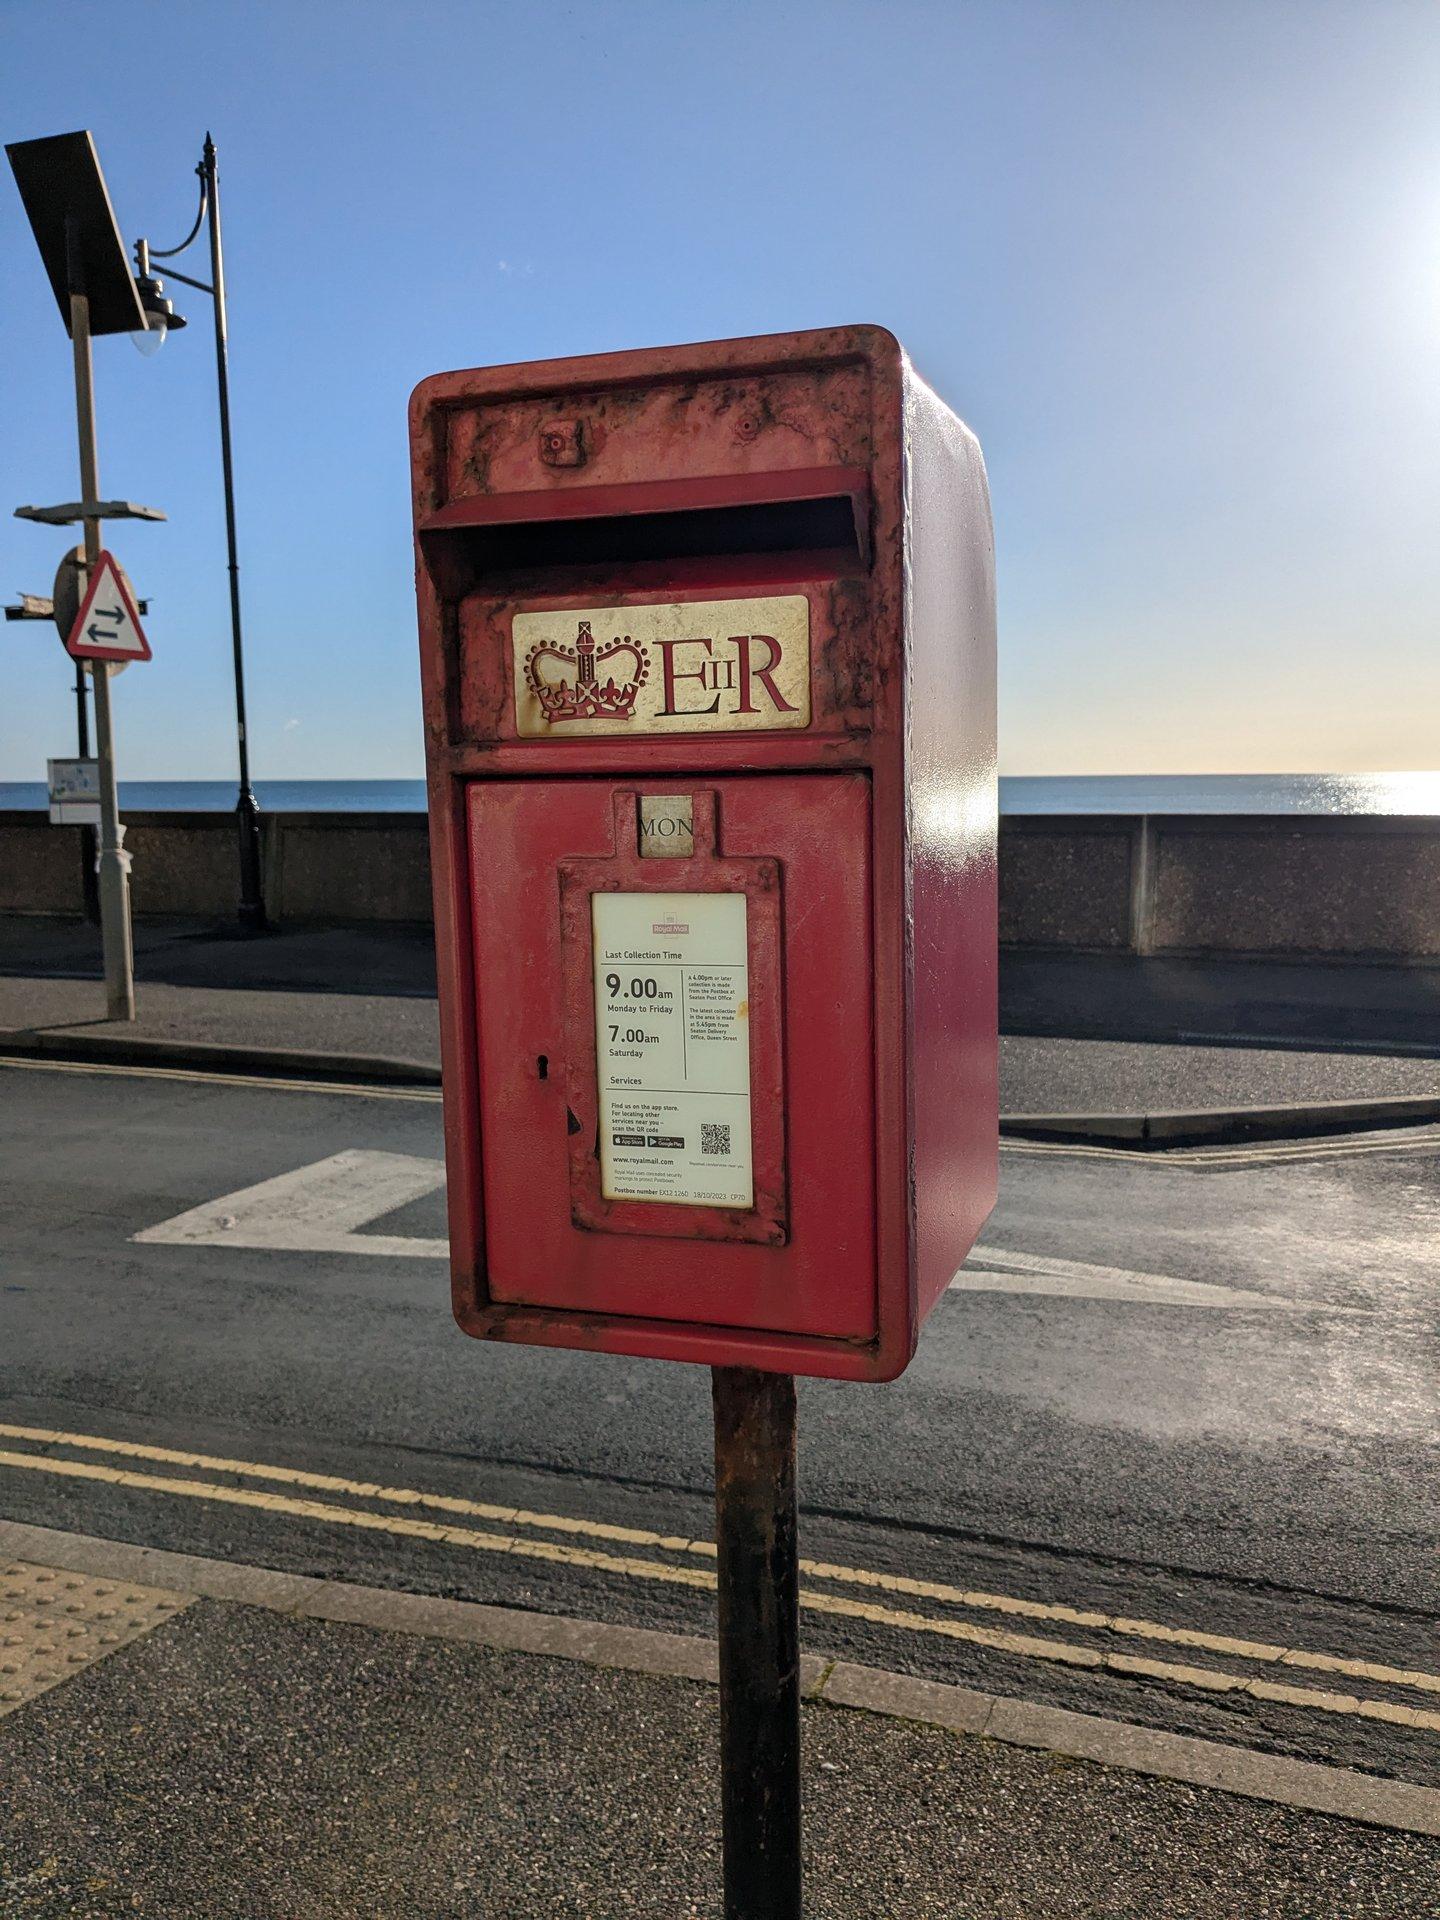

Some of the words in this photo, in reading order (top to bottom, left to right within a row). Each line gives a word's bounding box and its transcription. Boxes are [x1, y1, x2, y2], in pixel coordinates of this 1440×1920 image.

[640, 818, 693, 837] MON
[654, 924, 672, 933] Royal
[674, 924, 688, 932] Mail
[605, 951, 622, 959] Last
[624, 951, 660, 959] Collection
[662, 951, 682, 960] Time
[606, 973, 673, 998] 9.00am
[608, 1004, 636, 1014] Monday
[639, 1004, 647, 1012] to
[650, 1005, 674, 1014] Friday
[608, 1024, 660, 1043] 7.00am
[609, 1048, 644, 1058] Saturday
[610, 1076, 642, 1084] Services
[612, 1157, 674, 1166] www.royalmail.com
[694, 1192, 727, 1200] 18/10/2023
